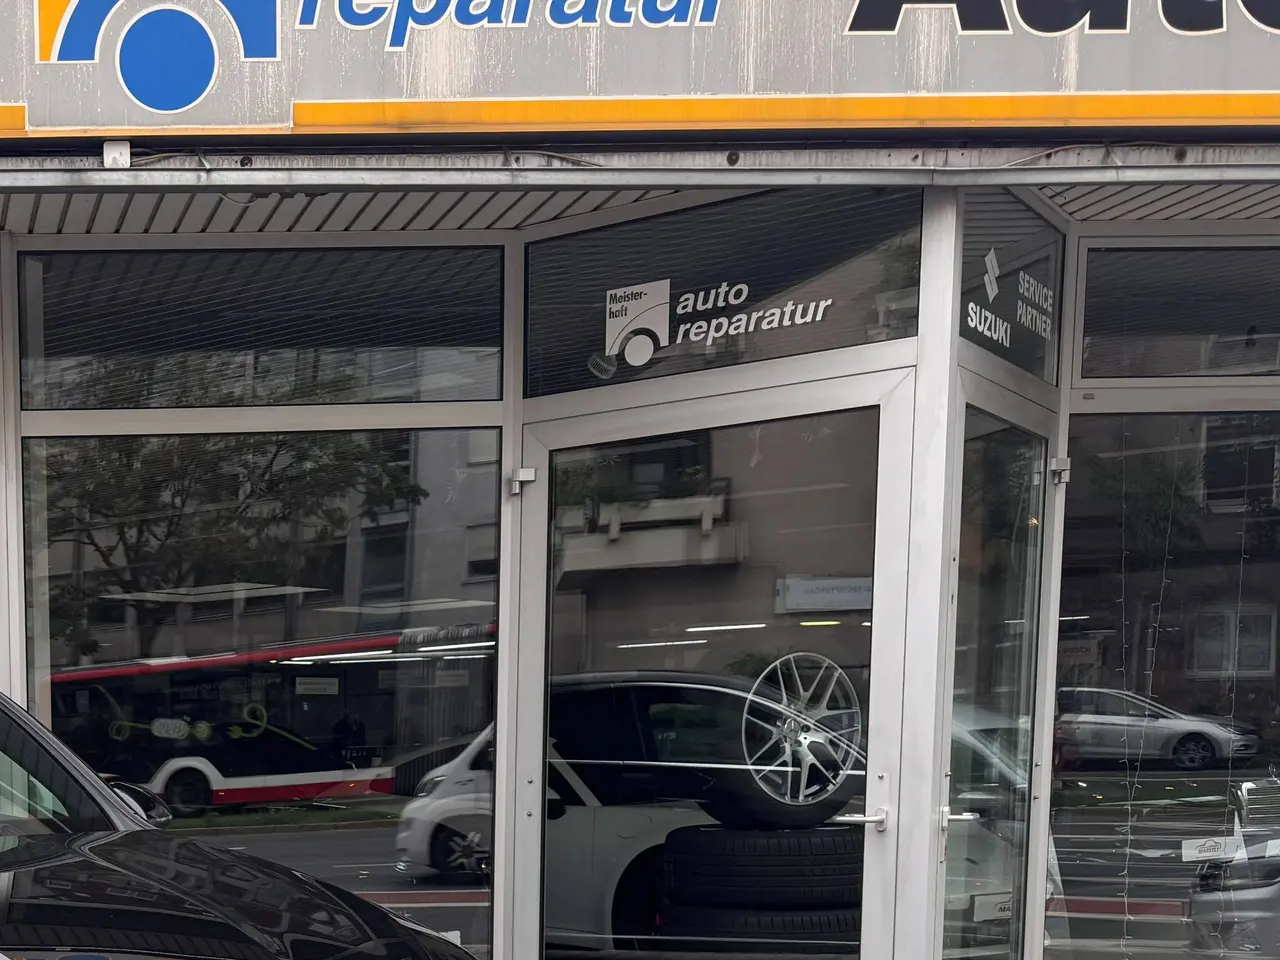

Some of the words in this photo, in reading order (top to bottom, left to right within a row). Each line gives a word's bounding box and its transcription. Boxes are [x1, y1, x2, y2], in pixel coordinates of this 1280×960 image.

[609, 290, 648, 305] Meister-
[609, 305, 628, 319] haft
[676, 282, 749, 314] auto
[1019, 271, 1052, 313] SERVICE
[676, 299, 832, 346] reparatur
[967, 302, 1011, 347] SUZUKI
[1017, 300, 1051, 340] PARTNER
